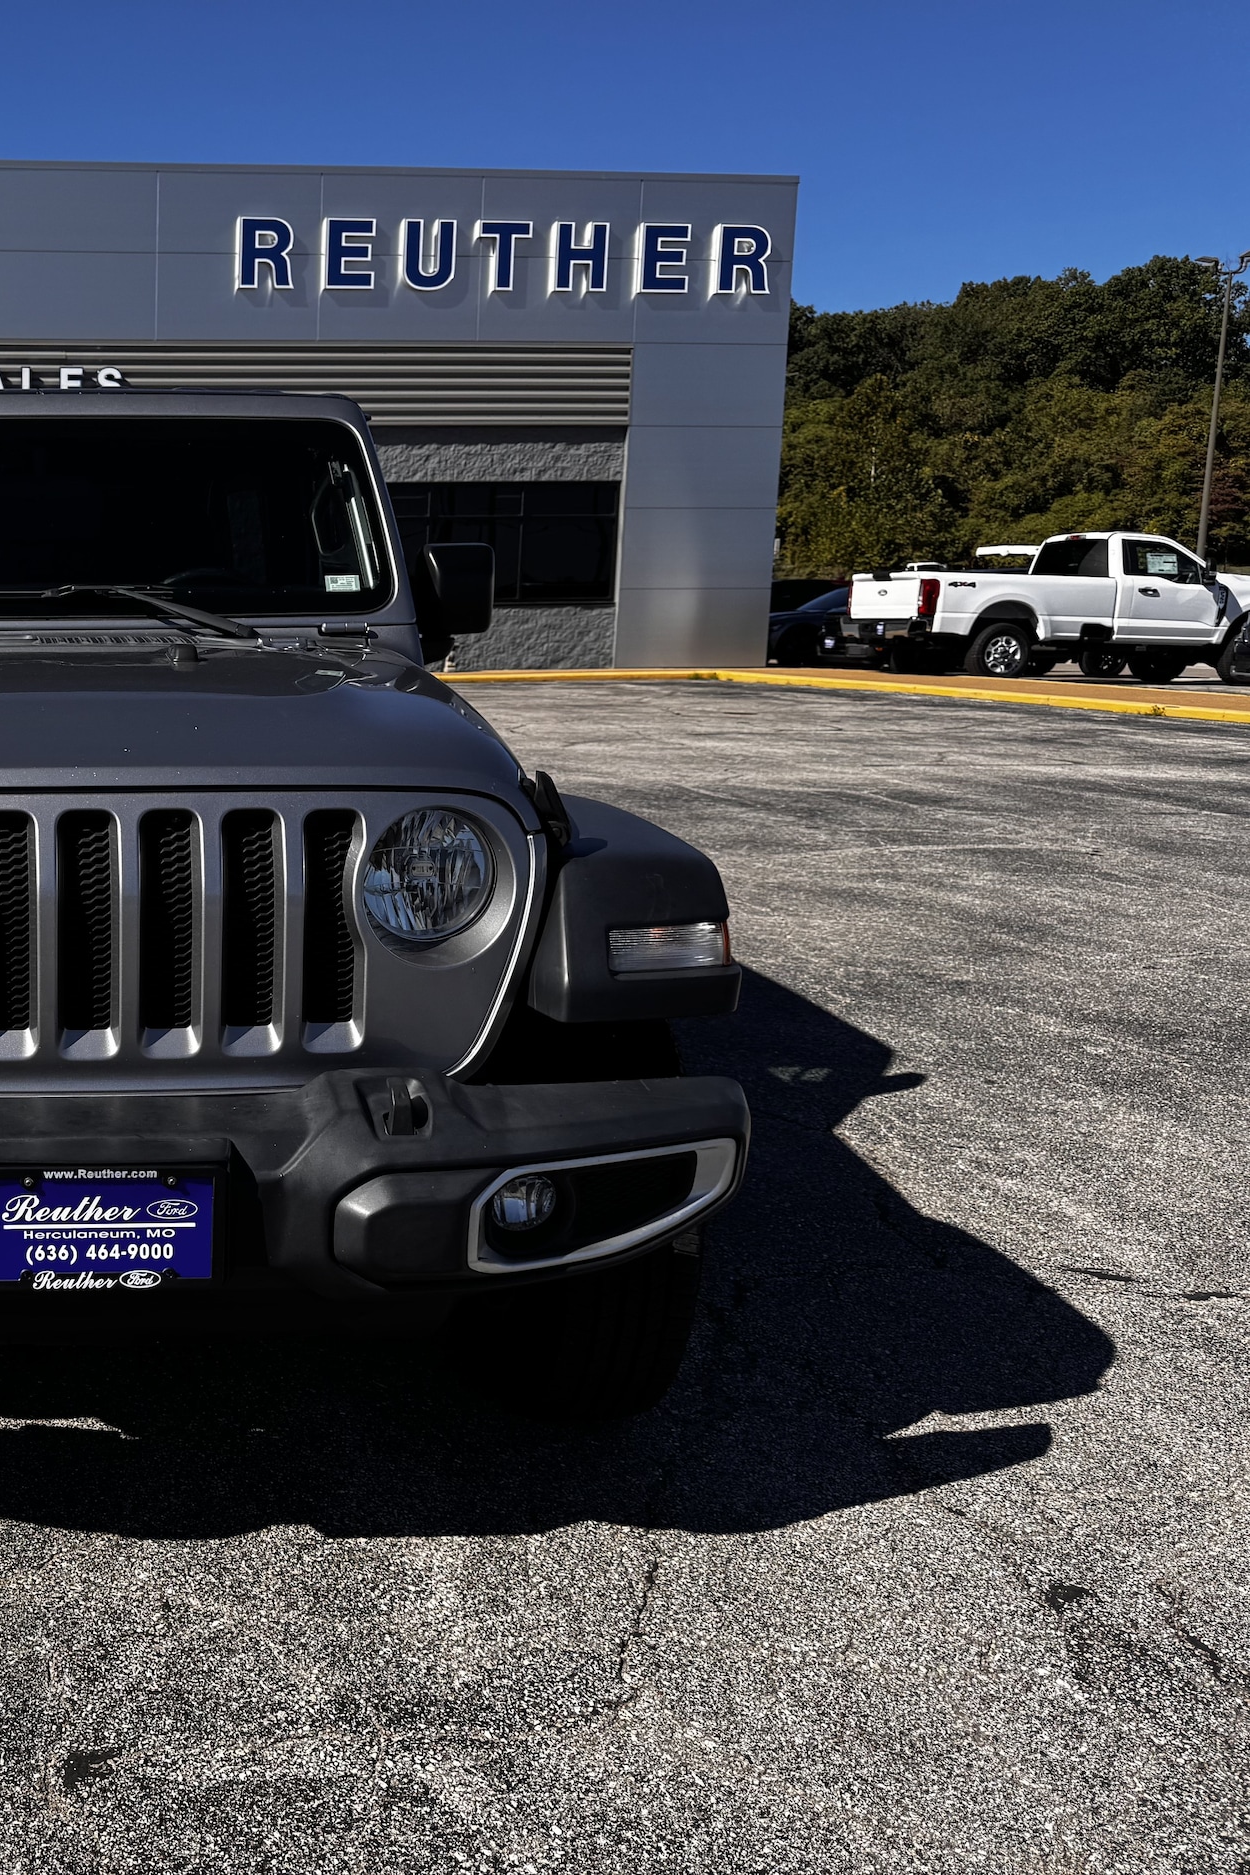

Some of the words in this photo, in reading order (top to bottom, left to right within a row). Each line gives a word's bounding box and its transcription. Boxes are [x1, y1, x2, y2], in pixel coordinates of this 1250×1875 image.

[235, 216, 772, 294] REUTHER
[43, 1169, 158, 1179] www.Reuther.com
[1, 1195, 141, 1223] Reuther
[156, 1202, 188, 1216] Ford
[23, 1230, 141, 1240] Herculaneum,
[146, 1229, 176, 1239] MO
[25, 1245, 78, 1265] (636)
[86, 1243, 174, 1260] 464-9000
[32, 1271, 118, 1290] Reuther
[127, 1273, 154, 1286] Ford
